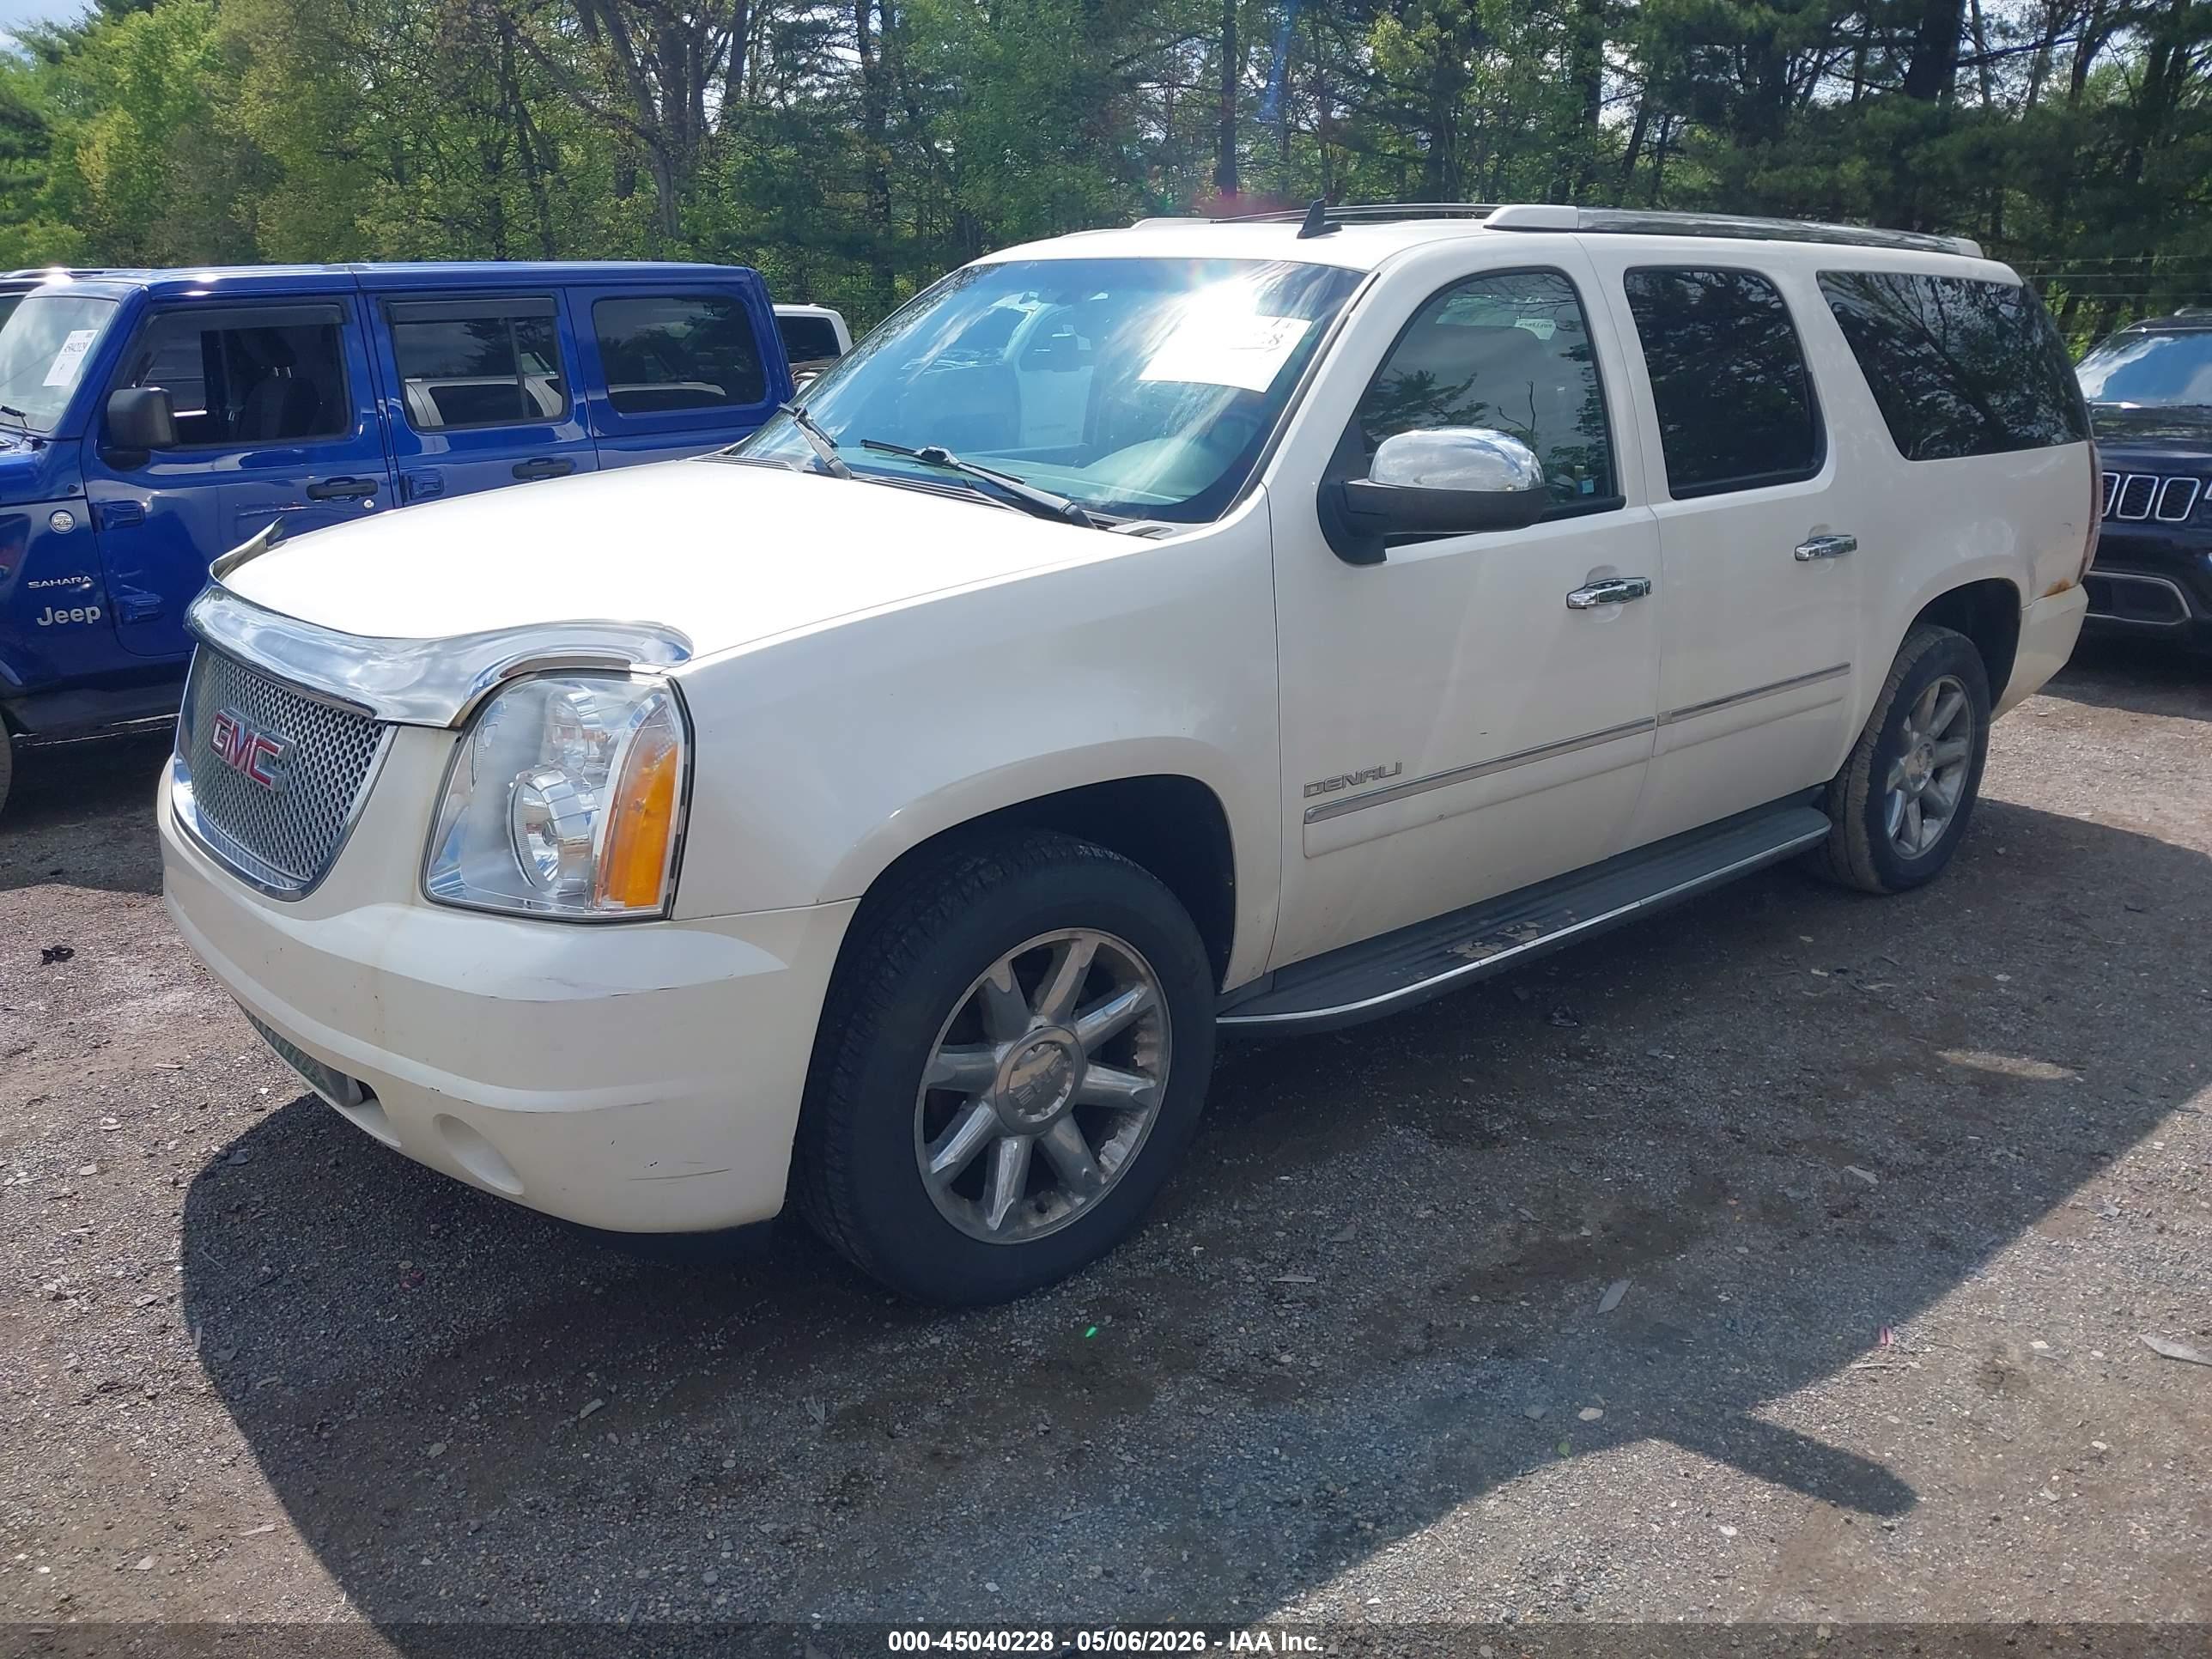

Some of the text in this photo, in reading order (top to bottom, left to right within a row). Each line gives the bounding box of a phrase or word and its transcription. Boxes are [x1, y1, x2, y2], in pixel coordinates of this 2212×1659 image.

[27, 575, 94, 589] SAHARA
[36, 605, 101, 626] Jeep
[210, 707, 295, 791] GMC
[1304, 762, 1402, 798] DENALI
